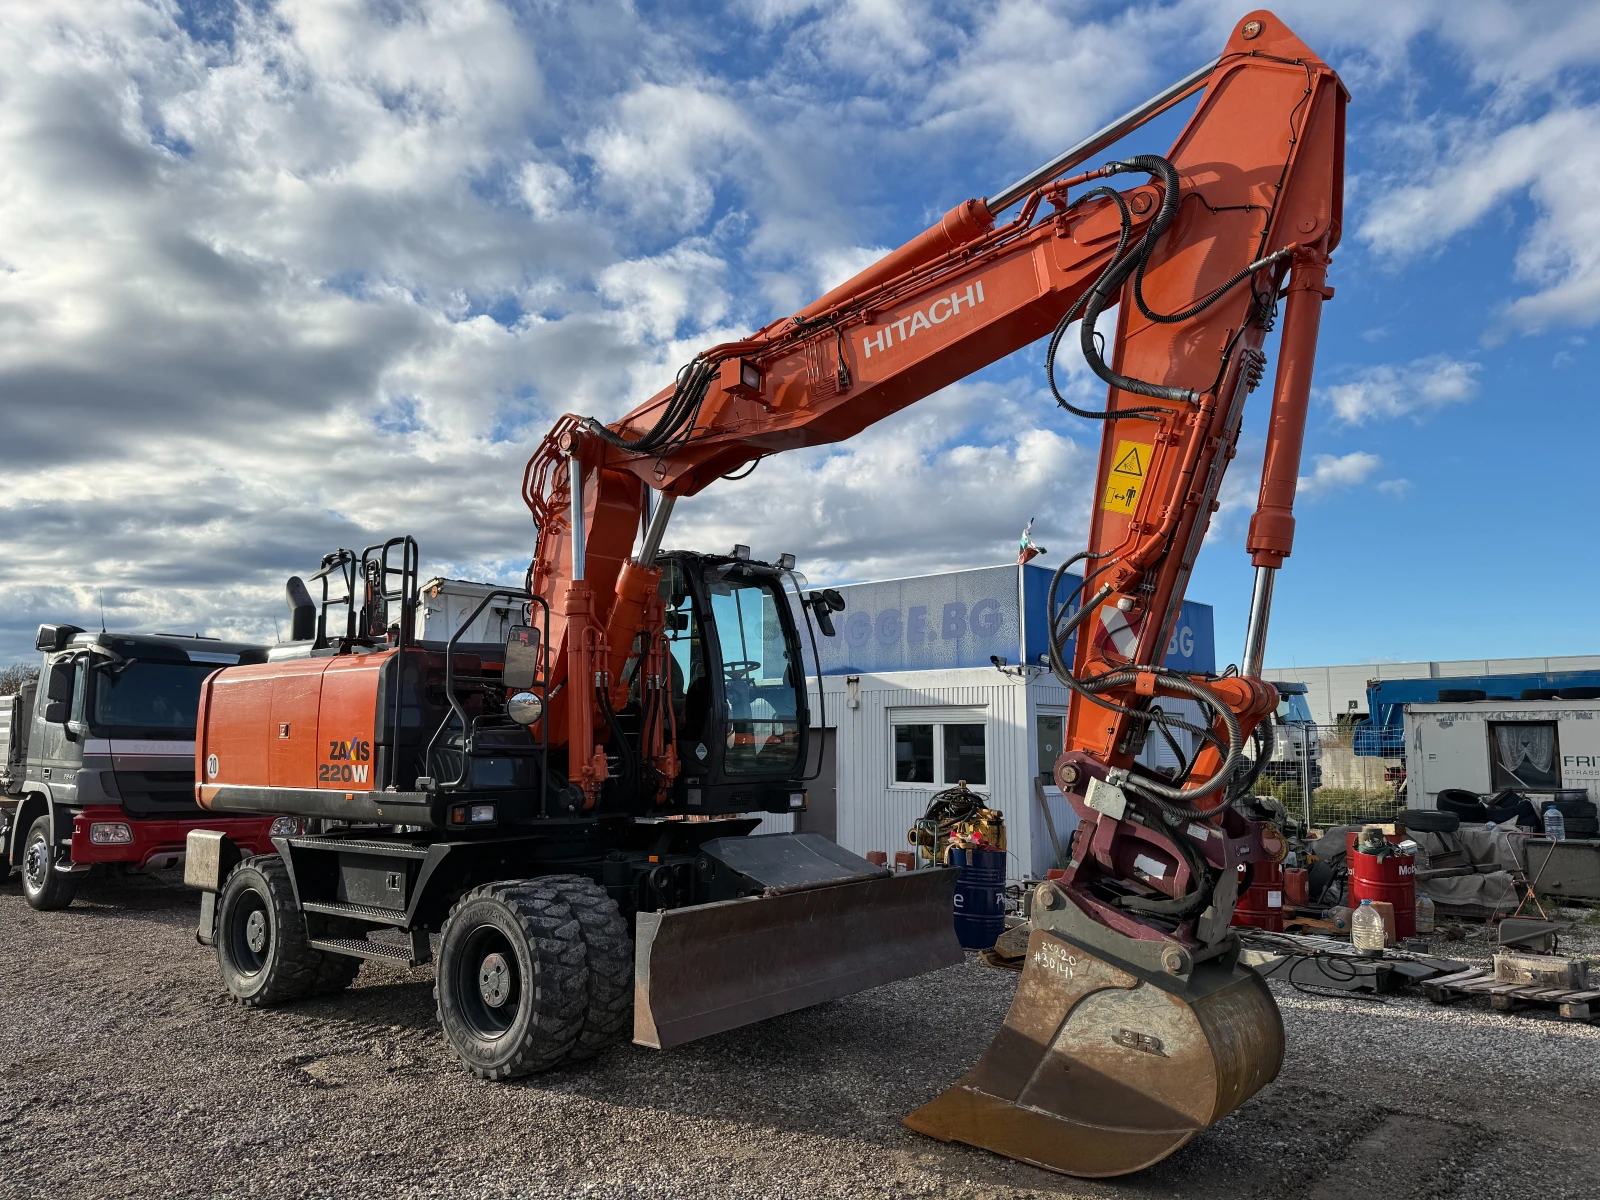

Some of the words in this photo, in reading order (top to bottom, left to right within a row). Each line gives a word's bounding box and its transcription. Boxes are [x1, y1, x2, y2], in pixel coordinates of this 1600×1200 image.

[862, 280, 985, 359] HITACHI
[329, 736, 371, 762] ZAXIS
[208, 757, 217, 775] 20
[318, 763, 369, 784] 220W
